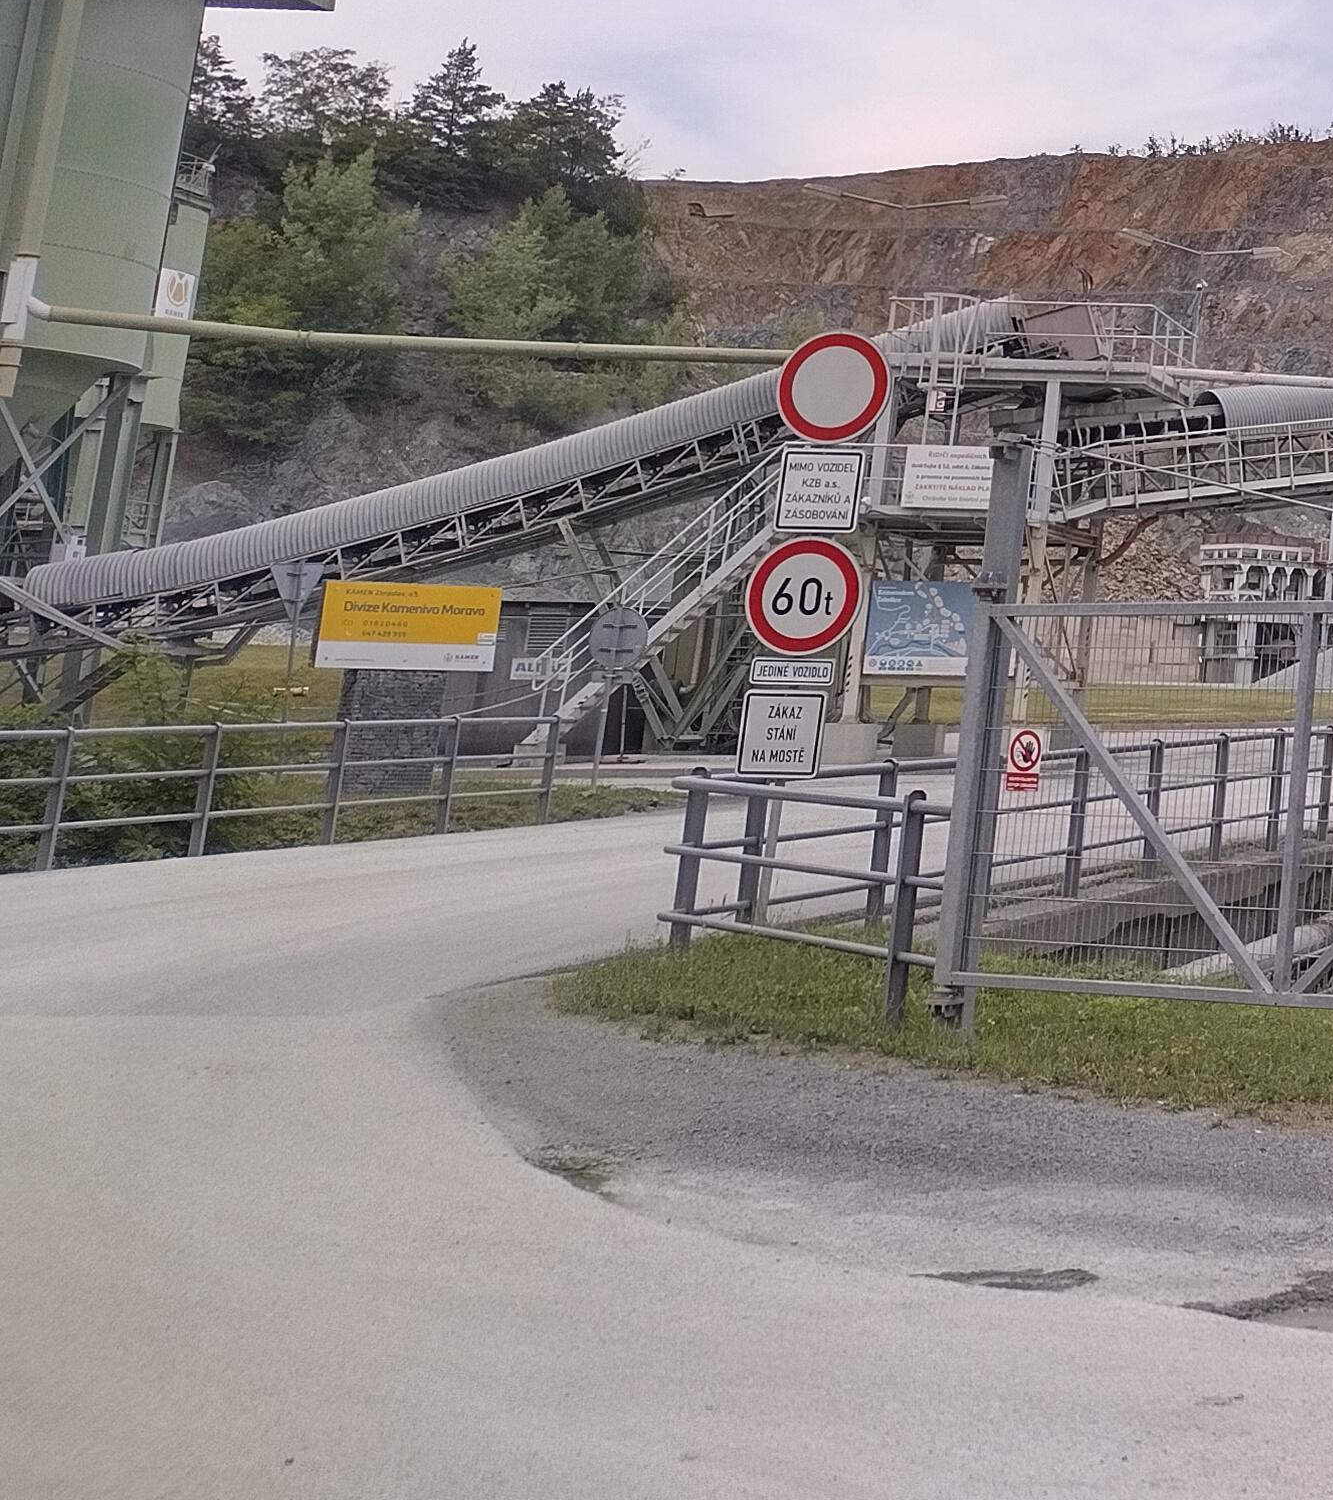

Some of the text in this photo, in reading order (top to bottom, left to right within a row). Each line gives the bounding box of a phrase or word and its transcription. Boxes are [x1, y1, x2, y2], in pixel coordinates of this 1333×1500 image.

[789, 462, 855, 473] MIMO VOZIDEL
[801, 478, 821, 488] KZB
[785, 492, 851, 504] ZÁKAZNÍKŮ A
[784, 508, 848, 520] ZÁSOBOVÁNÍ
[344, 600, 486, 616] Divize Kamenivo Morava
[757, 663, 829, 678] JEDINÉ VOZIDLO
[768, 702, 803, 719] ZÁKAZ
[766, 725, 797, 741] STÁNÍ
[751, 747, 805, 763] NA MOSTĚ
